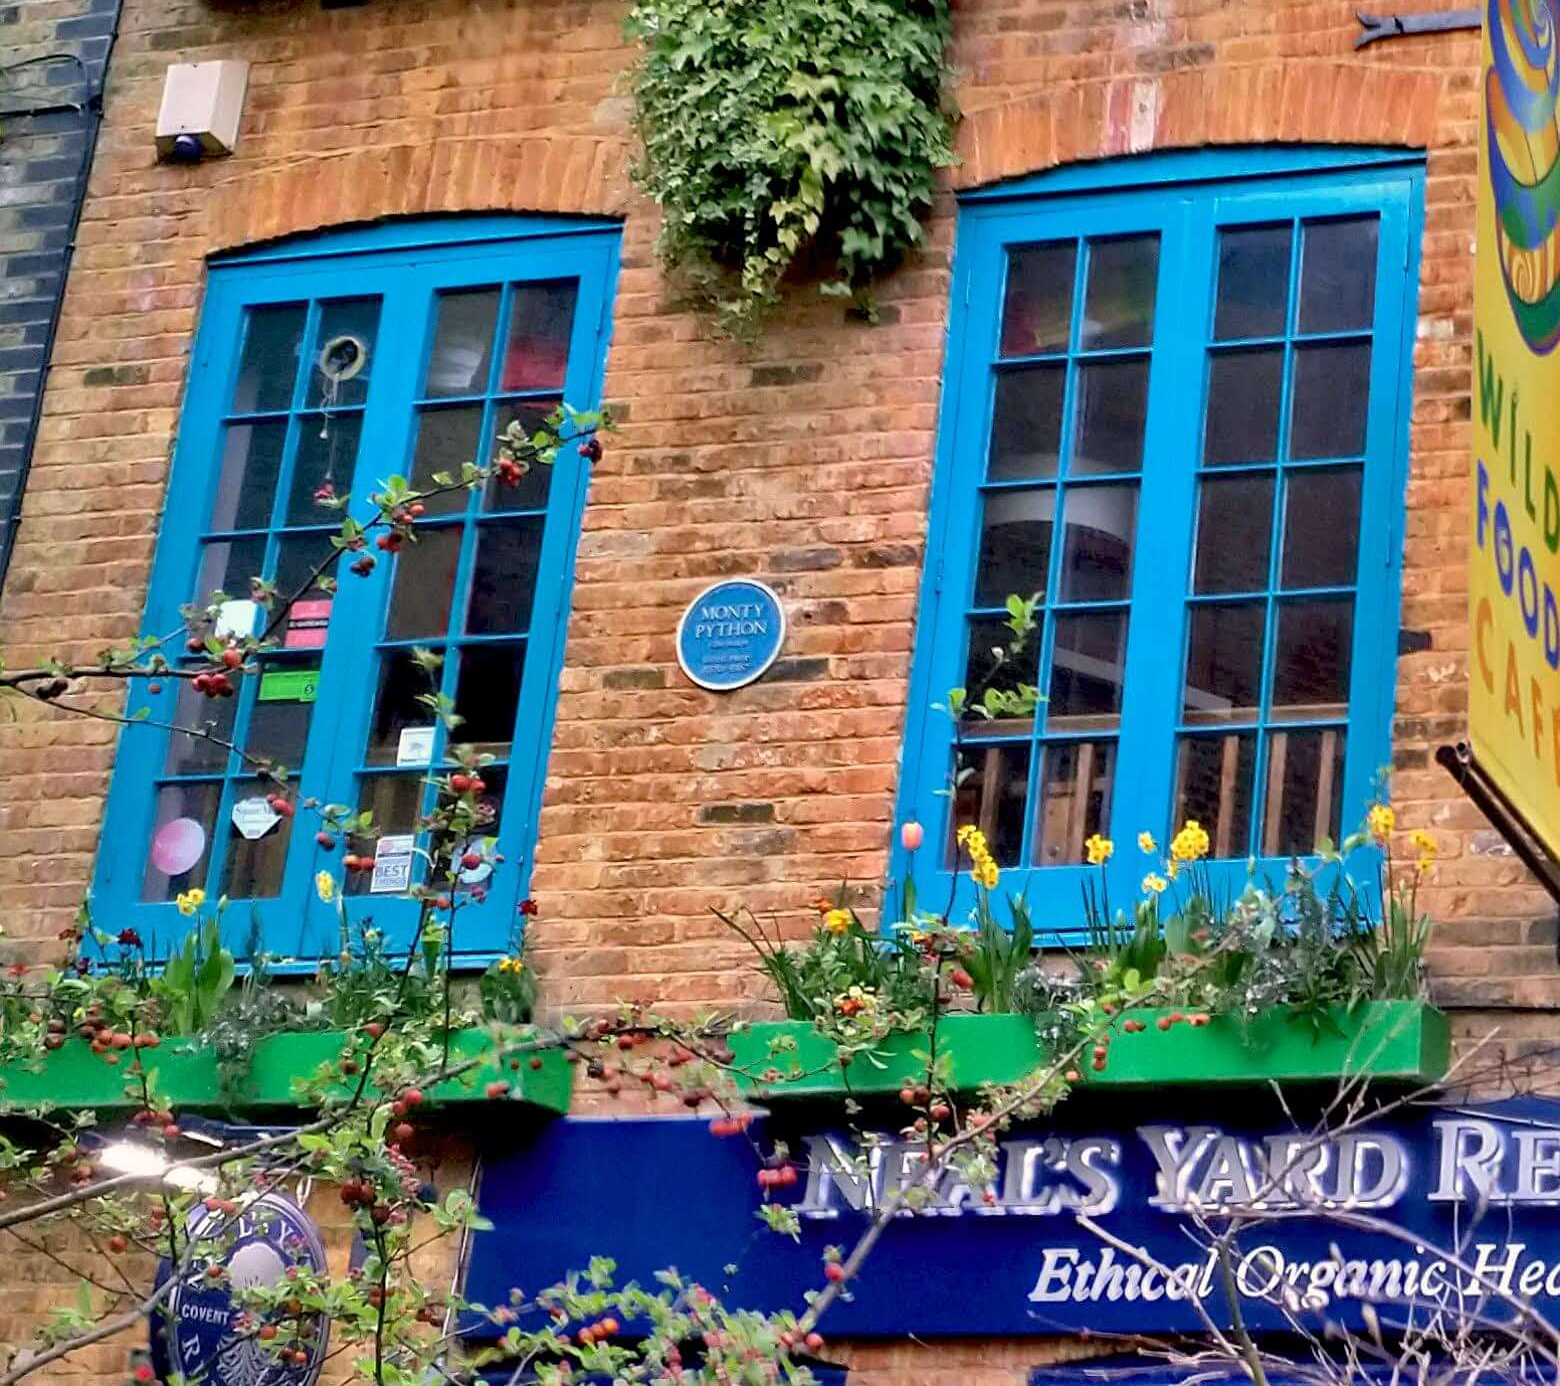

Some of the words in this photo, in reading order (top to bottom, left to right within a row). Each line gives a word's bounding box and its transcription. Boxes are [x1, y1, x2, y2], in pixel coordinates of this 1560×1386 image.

[1476, 327, 1560, 554] WILD
[1476, 458, 1560, 671] FOOD
[695, 621, 768, 638] PYTHON
[701, 604, 764, 620] MONTY
[1134, 1123, 1408, 1213] YARD
[1027, 1246, 1219, 1303] Ethical
[1237, 1245, 1446, 1310] Organic
[181, 1304, 230, 1326] COVENT
